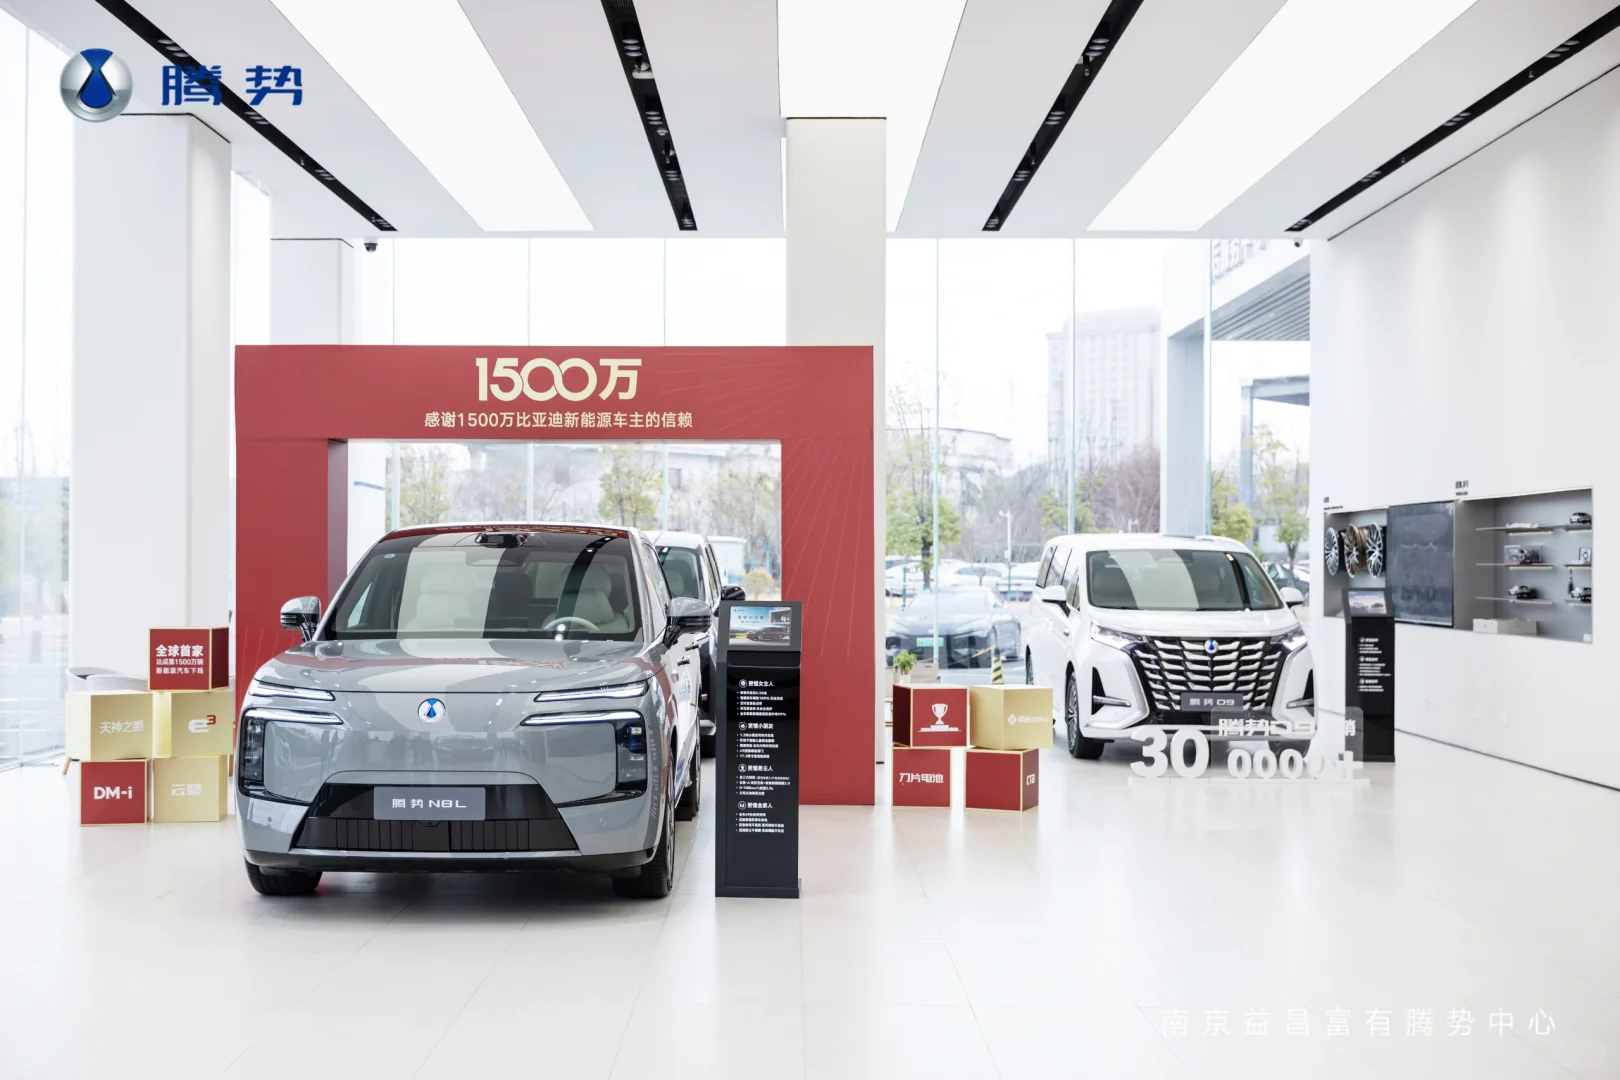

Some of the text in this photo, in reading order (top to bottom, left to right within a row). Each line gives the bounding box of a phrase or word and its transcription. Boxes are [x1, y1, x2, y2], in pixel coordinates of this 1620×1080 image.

[476, 357, 642, 402] 1500万
[424, 412, 693, 428] 感谢1500万比亚迪新能源车主的信赖
[156, 644, 204, 657] 全球首家
[99, 720, 144, 735] 天神之眼
[1130, 726, 1210, 779] 30
[899, 773, 944, 784] 刀片电池
[93, 786, 133, 800] DM-i
[391, 798, 424, 809] 腾势
